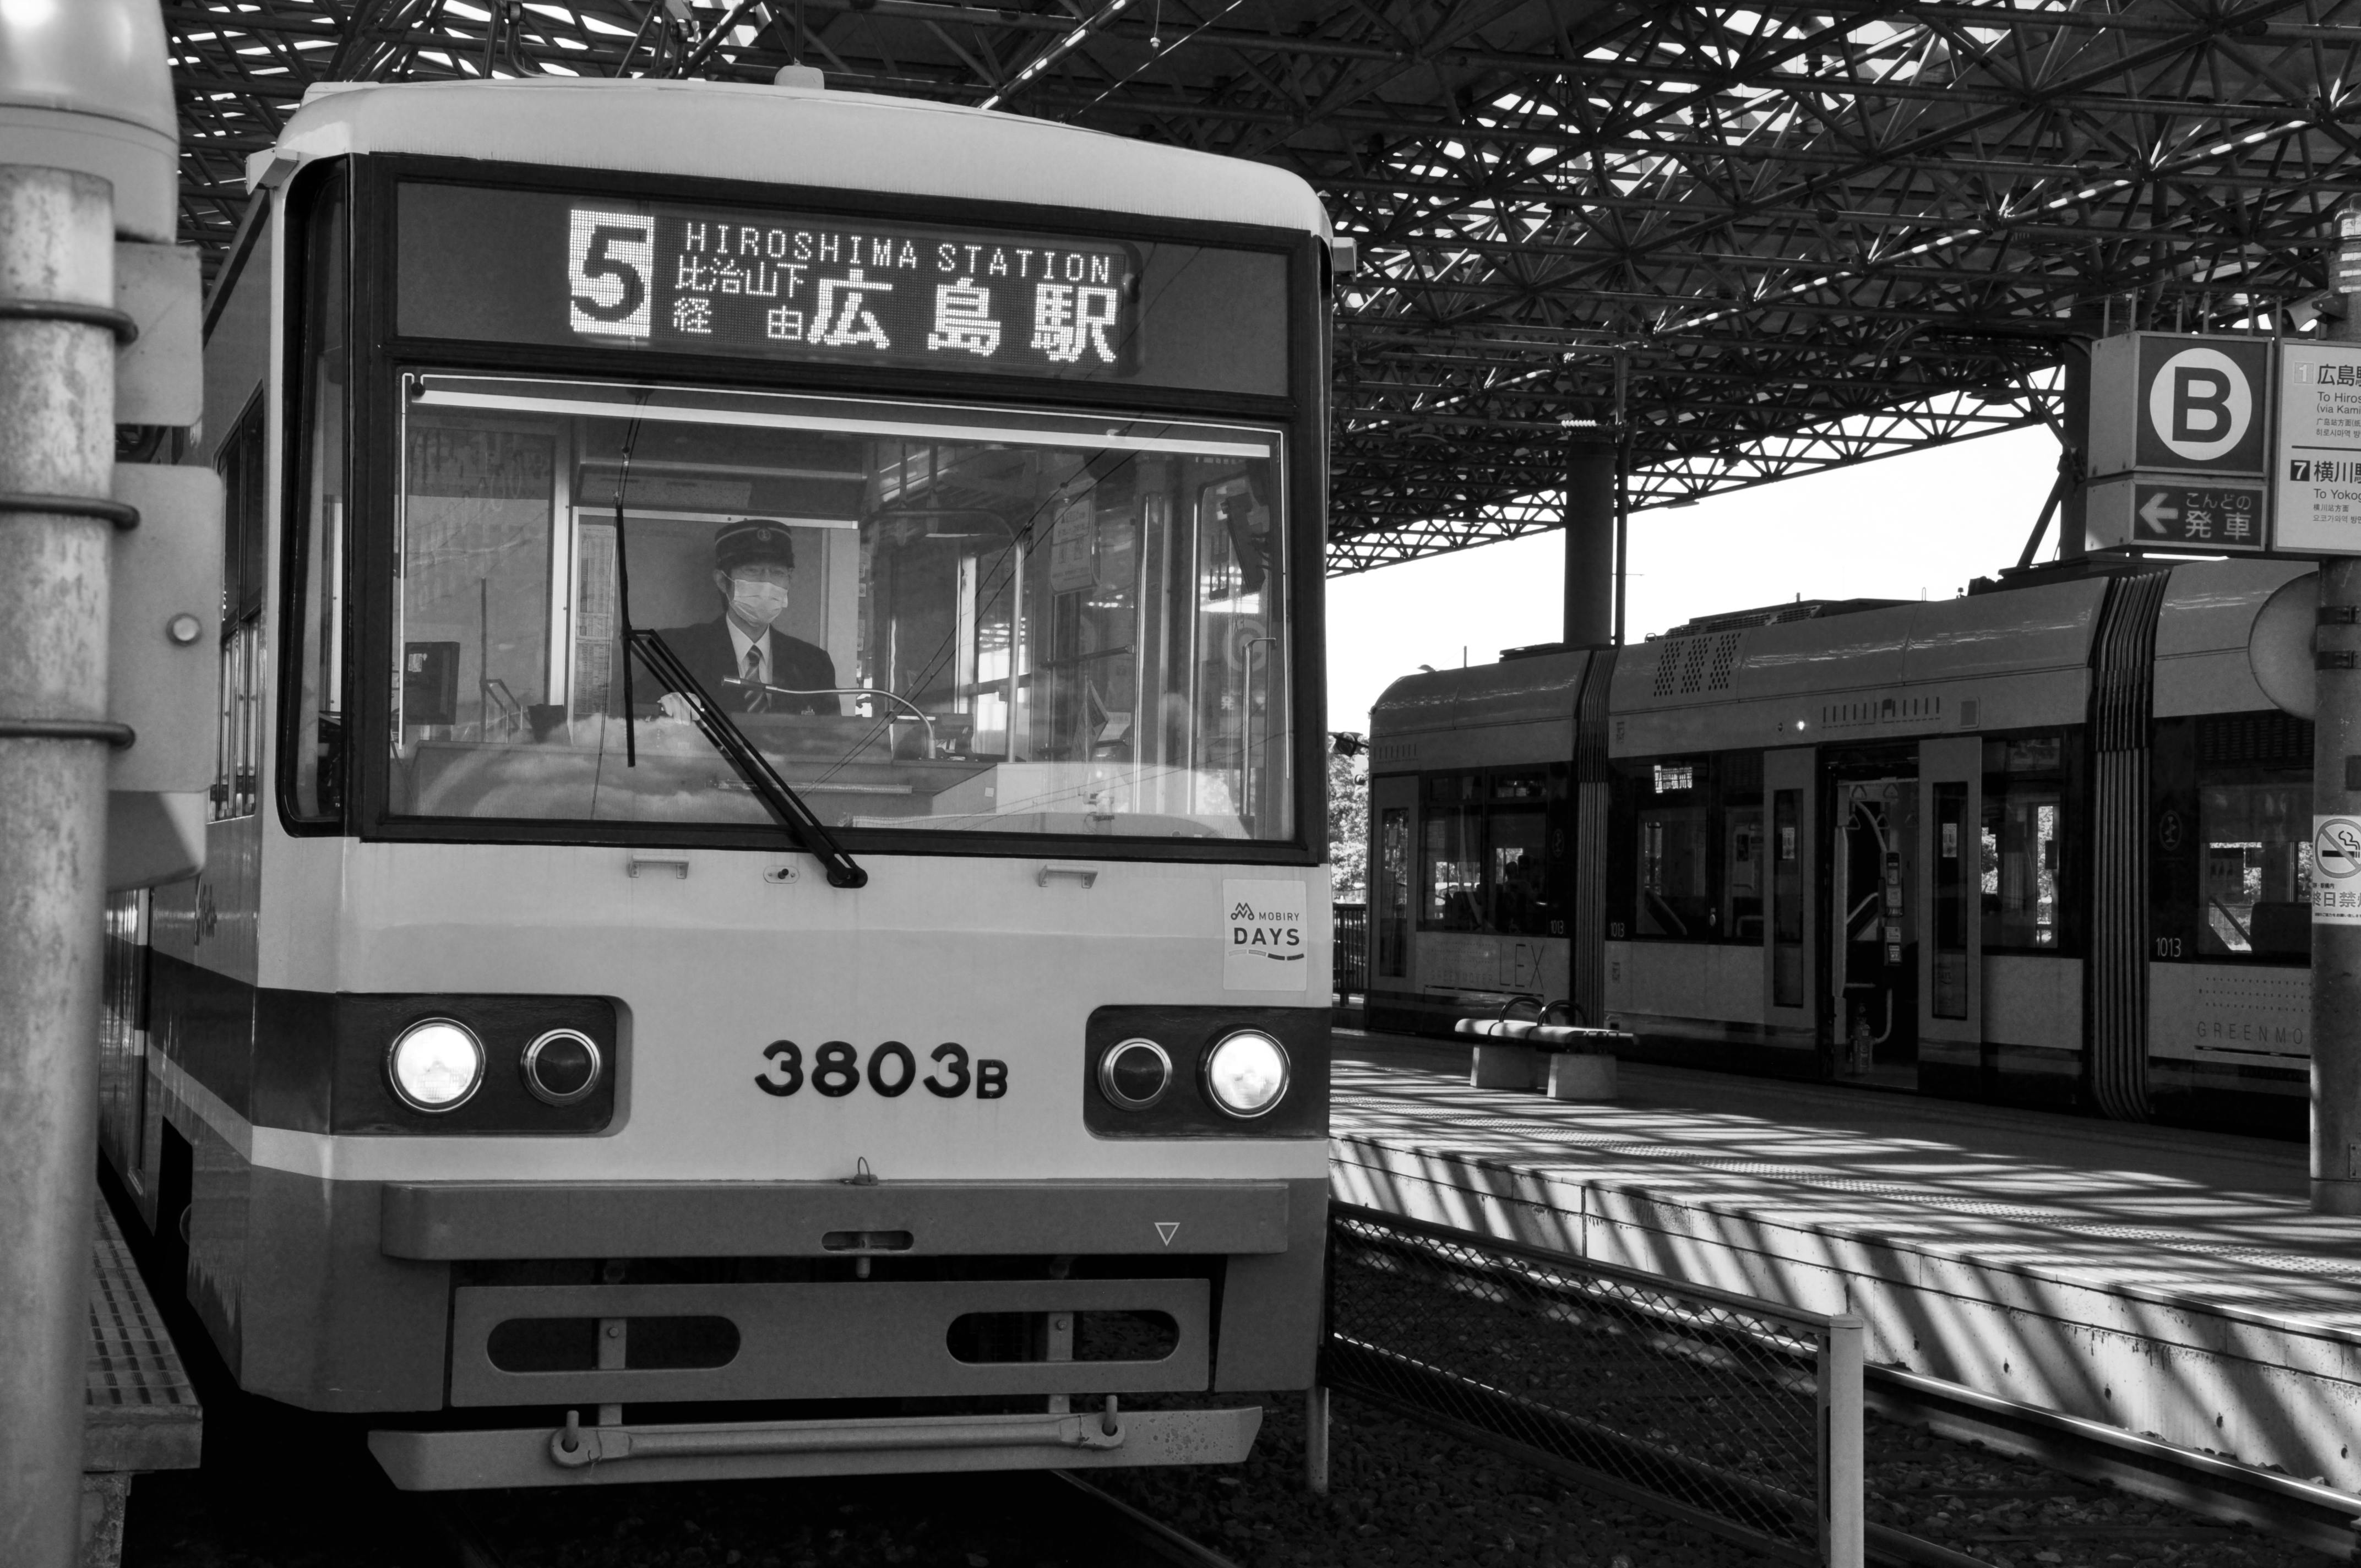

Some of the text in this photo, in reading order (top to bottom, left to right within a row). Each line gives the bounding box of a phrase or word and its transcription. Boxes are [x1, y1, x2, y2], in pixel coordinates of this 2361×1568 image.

[687, 221, 1110, 284] HIROSHIMA STATION
[571, 223, 646, 323] 5
[674, 254, 808, 298] 比治山下
[807, 269, 1118, 363] 広島駅
[2299, 363, 2361, 387] 1 広島
[2172, 366, 2232, 443] B
[2317, 391, 2331, 402] To
[2317, 402, 2334, 413] (via
[2294, 461, 2307, 480] 7
[2186, 493, 2251, 510] こんどの
[2314, 488, 2327, 499] To
[2185, 510, 2252, 540] 発車
[2313, 891, 2361, 908] 終日禁
[1259, 911, 1300, 921] MOBIRY
[1233, 927, 1301, 946] DAYS
[1551, 920, 1564, 934] 1013
[1611, 922, 1624, 937] 1013
[2156, 937, 2182, 957] 1013
[1499, 943, 1545, 989] LEX
